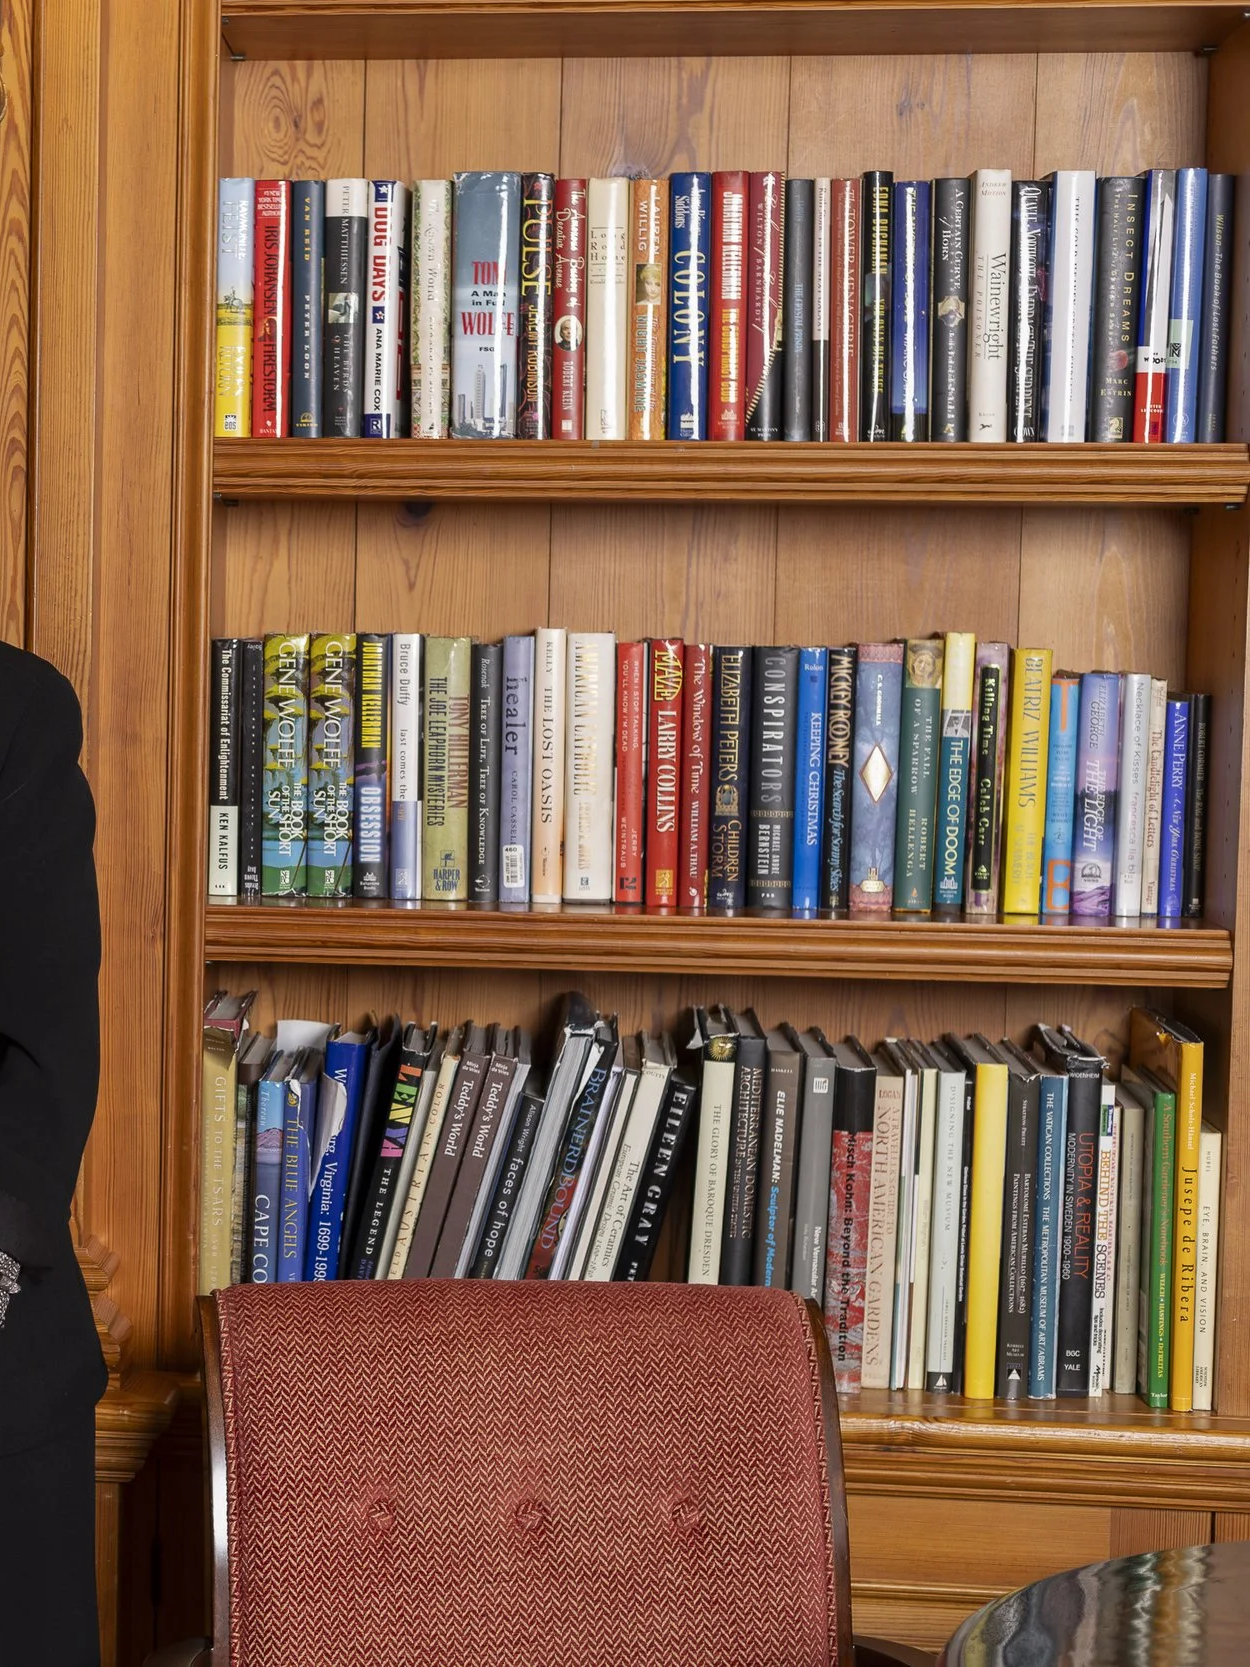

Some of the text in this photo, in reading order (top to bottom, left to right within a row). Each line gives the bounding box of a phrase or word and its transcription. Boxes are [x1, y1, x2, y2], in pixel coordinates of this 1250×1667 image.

[264, 226, 280, 251] IRIS
[341, 185, 350, 284] PETER MATTHIESSEN
[372, 207, 392, 302] DOG DAYS
[521, 196, 553, 296] PULSE
[554, 207, 571, 288] Decatur Avenue
[638, 200, 648, 252] WILLIG
[674, 195, 690, 229] Siddons
[721, 191, 743, 299] JONATHAN KELLERMAN
[872, 187, 889, 274] EDNA BUCHANAN
[953, 188, 964, 290] A CERTAIN CURVE
[262, 255, 280, 314] JOHANSEN
[471, 261, 507, 285] TOM
[673, 250, 706, 367] COLONY
[754, 203, 764, 323] WILTON BARNHARDT
[975, 256, 985, 358] THE POISONER
[982, 252, 1007, 360] Wainewright
[1121, 193, 1139, 343] INSECT DREAMS
[262, 343, 277, 412] FIRESTORM
[333, 347, 341, 391] HEAVEN
[375, 328, 383, 350] ANA
[561, 360, 574, 411] ROBERT KLEIN
[635, 315, 648, 413] NIGHT JASMINE
[1100, 389, 1132, 397] ESTRIN
[277, 642, 296, 768] GENE WOLFE
[323, 641, 343, 768] GENE WOLFE
[361, 641, 383, 748] JONATHAN KELLERMAN
[397, 643, 411, 706] Bruce Duffy
[504, 675, 528, 756] healer
[654, 649, 683, 701] MAZE
[718, 654, 741, 782] ELIZABETH PETERS
[1022, 657, 1044, 722] BEATRIZ
[426, 677, 448, 827] THE JOE LEAPHORN MYSTERIES
[447, 694, 470, 809] TONY HILLERMAN
[541, 641, 554, 824] KELLY THE LOST OASIS
[656, 709, 677, 833] LARRY COLLINS
[689, 659, 706, 794] The Window of Time
[760, 656, 787, 803] CONSPIRATORS
[978, 678, 996, 846] Killing Time Caleb Carr
[1018, 730, 1040, 808] WILLIAMS
[1089, 700, 1100, 749] GEORGE
[360, 786, 382, 863] OBSESSION
[806, 712, 821, 846] KEEPING CHRISTMAS
[944, 739, 964, 875] THE EDGE OF DOOM
[218, 812, 229, 870] KEN KALFUS
[723, 819, 742, 882] CHILDREN
[757, 824, 771, 875] BERNSTEIN
[380, 1063, 423, 1158] LENYA
[516, 1128, 530, 1153] Wright
[524, 1103, 538, 1127] Alison
[740, 1067, 763, 1240] MEDITERRANEAN DOMESTIC
[283, 1118, 299, 1259] THE BLUE ANGELS
[496, 1200, 510, 1217] of
[503, 1156, 524, 1195] faces
[601, 1161, 641, 1268] The Art of Ceramics
[634, 1090, 689, 1247] EILEEN GRAY
[701, 1104, 722, 1277] THE GLORY OF BAROQUE DRESDEN
[1073, 1132, 1095, 1280] UTOPIA & REALITY
[484, 1220, 504, 1258] hope
[837, 1132, 857, 1362] Misch Kohn: Beyond the Tradition
[866, 1106, 891, 1366] NORTH AMERICAN GARDENS
[1037, 1092, 1055, 1381] THE VATICAN COLLECTIONS THE METROPOLITAN MUSEUM OF ART/ABRAMS
[1094, 1149, 1112, 1299] BEHIND THE SCENES
